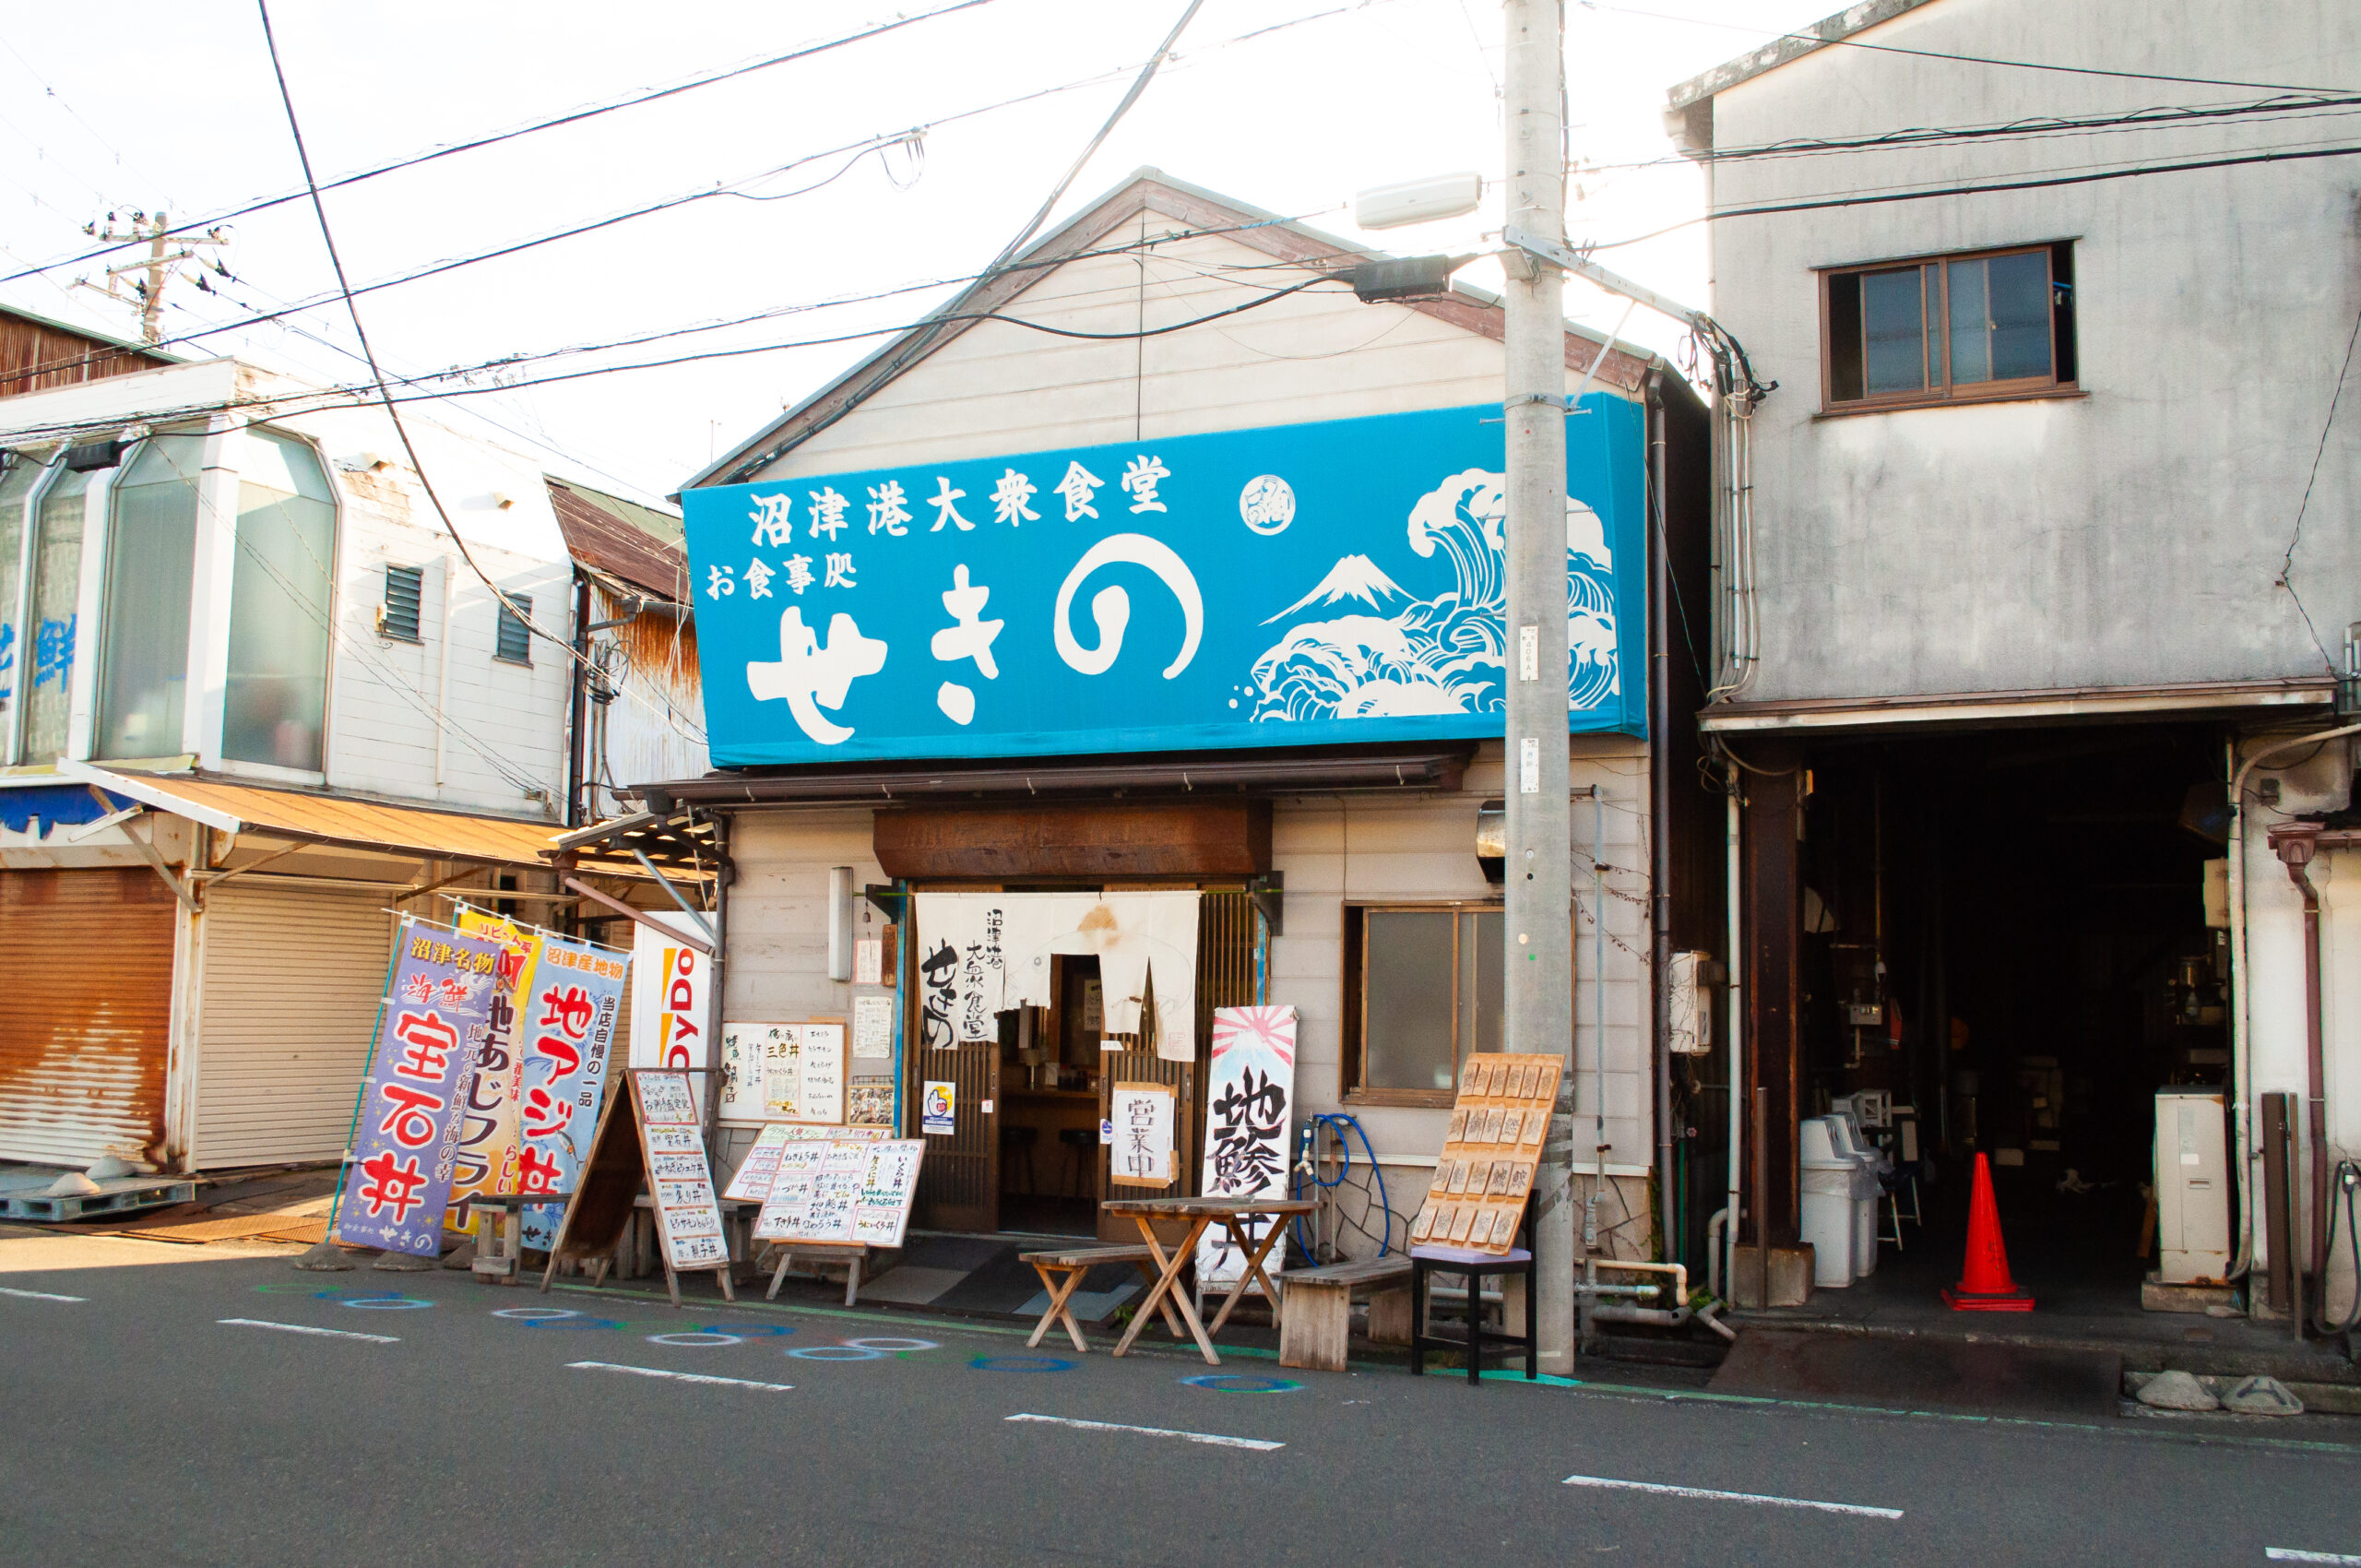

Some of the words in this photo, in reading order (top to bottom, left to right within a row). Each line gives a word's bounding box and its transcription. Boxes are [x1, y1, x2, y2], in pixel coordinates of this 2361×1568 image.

[748, 455, 1171, 549] 沼津港大衆食堂
[706, 552, 858, 600] お食事処
[746, 532, 1204, 745] せきの
[410, 936, 496, 975] 沼津名物
[546, 945, 624, 981] 沼津産地物
[986, 909, 1003, 970] 沼津港
[408, 973, 469, 1013] 海鮮
[920, 937, 958, 1049] せきの
[963, 939, 988, 1039] 大衆食堂
[578, 996, 616, 1108] 当店自慢の一品
[766, 1042, 800, 1059] 三色丼
[356, 1013, 459, 1223] 宝石丼
[434, 1023, 483, 1183] 地元の新鮮な海の幸
[517, 986, 593, 1210] 地アジ丼
[1126, 1099, 1155, 1179] 営業中
[379, 1225, 433, 1251] せきの
